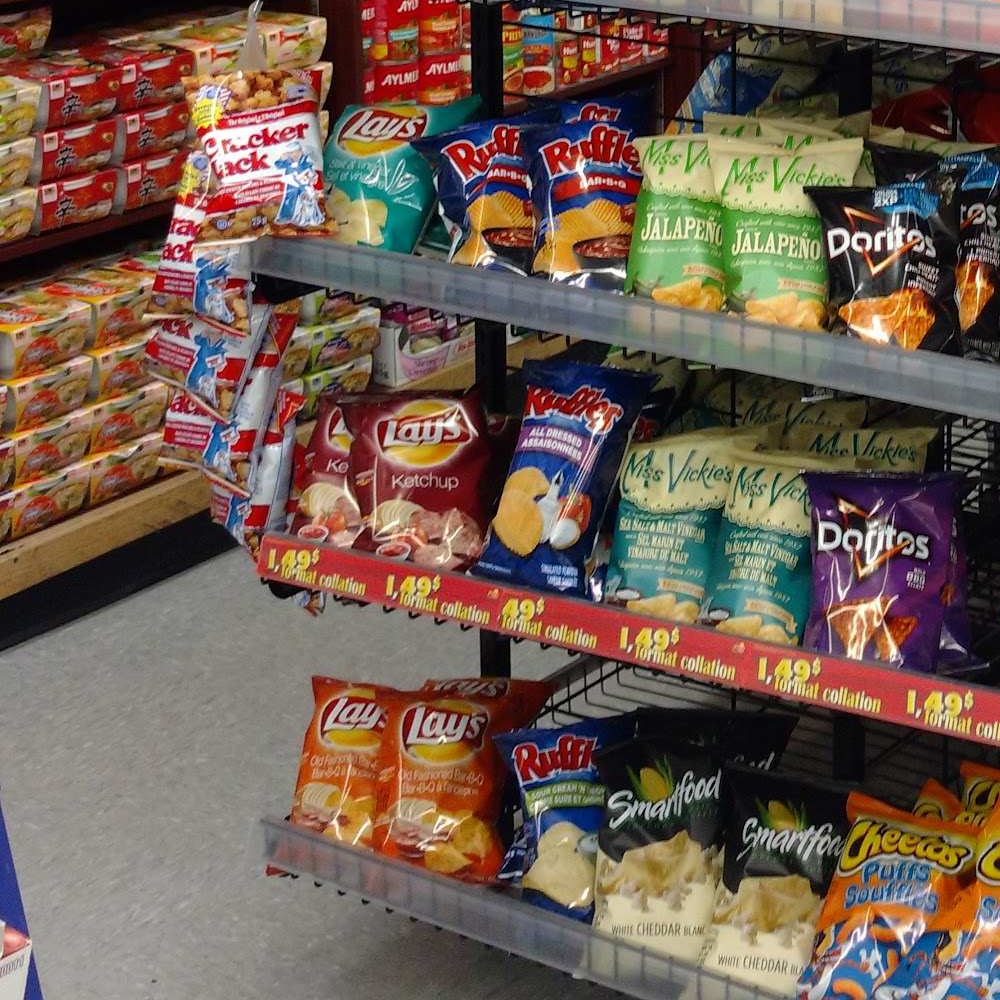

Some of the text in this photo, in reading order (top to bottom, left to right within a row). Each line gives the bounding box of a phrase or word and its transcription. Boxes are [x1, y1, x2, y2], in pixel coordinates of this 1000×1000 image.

[347, 110, 426, 142] Lay's
[442, 124, 523, 185] Ruff
[539, 123, 643, 180] Ruffle
[722, 157, 846, 197] Miss Vickie's
[641, 213, 723, 246] JALAPEÑO
[731, 229, 822, 262] JALAPEÑO
[826, 227, 937, 259] Doritos
[382, 411, 463, 448] Lay's
[529, 427, 583, 448] ALL DRESSED
[391, 472, 459, 491] Ketchup
[622, 449, 734, 494] Miss Vickie's
[817, 520, 930, 561] Doritos
[319, 574, 366, 597] collation
[440, 598, 490, 625] collation
[545, 623, 598, 650] collation
[680, 653, 735, 681] collation
[822, 685, 882, 714] collation
[407, 705, 487, 746] Lay's
[608, 767, 722, 830] Smartfood
[736, 816, 846, 862] Smartfoo
[839, 820, 973, 874] Cheetos
[861, 861, 931, 886] Puffs
[611, 923, 633, 936] WHITE
[636, 922, 681, 936] CHEDDAR
[718, 955, 789, 974] WHITE CHEDDAR
